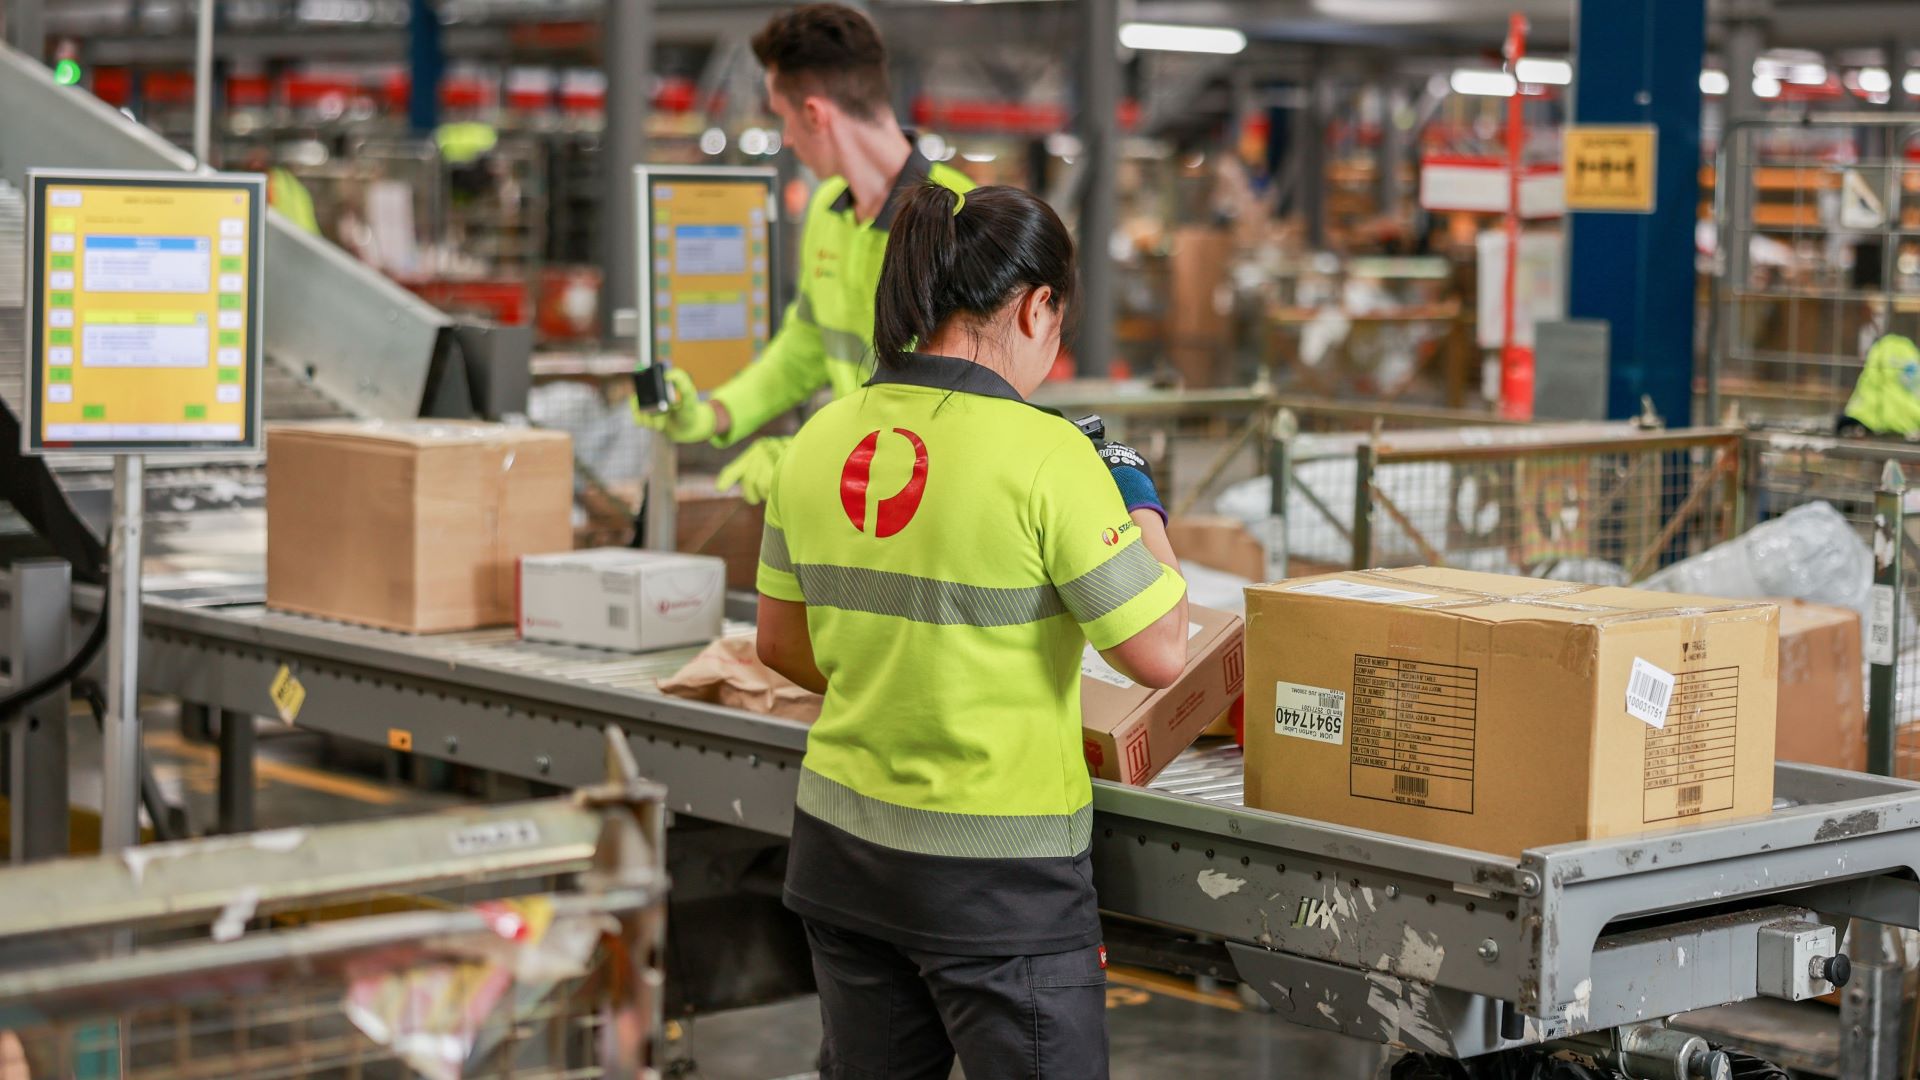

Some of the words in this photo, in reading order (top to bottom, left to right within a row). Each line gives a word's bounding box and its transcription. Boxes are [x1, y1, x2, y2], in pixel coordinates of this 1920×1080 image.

[1357, 656, 1370, 665] ORDER
[1372, 658, 1388, 666] NUMBER
[1356, 667, 1376, 675] COMPANY
[1372, 679, 1395, 688] DESCRIPTION
[1356, 686, 1366, 694] ITEM
[1368, 688, 1385, 696] NUMBER
[1355, 696, 1371, 704] COLOUR
[1629, 696, 1663, 720] 100031751
[1276, 708, 1341, 733] 59417440
[1354, 716, 1375, 724] QUANTITY
[1299, 729, 1317, 737] Carton
[1354, 725, 1370, 734] CARTON
[1320, 732, 1333, 740] UOM
[1352, 755, 1369, 763] CARTON
[1370, 758, 1387, 766] NUMBER
